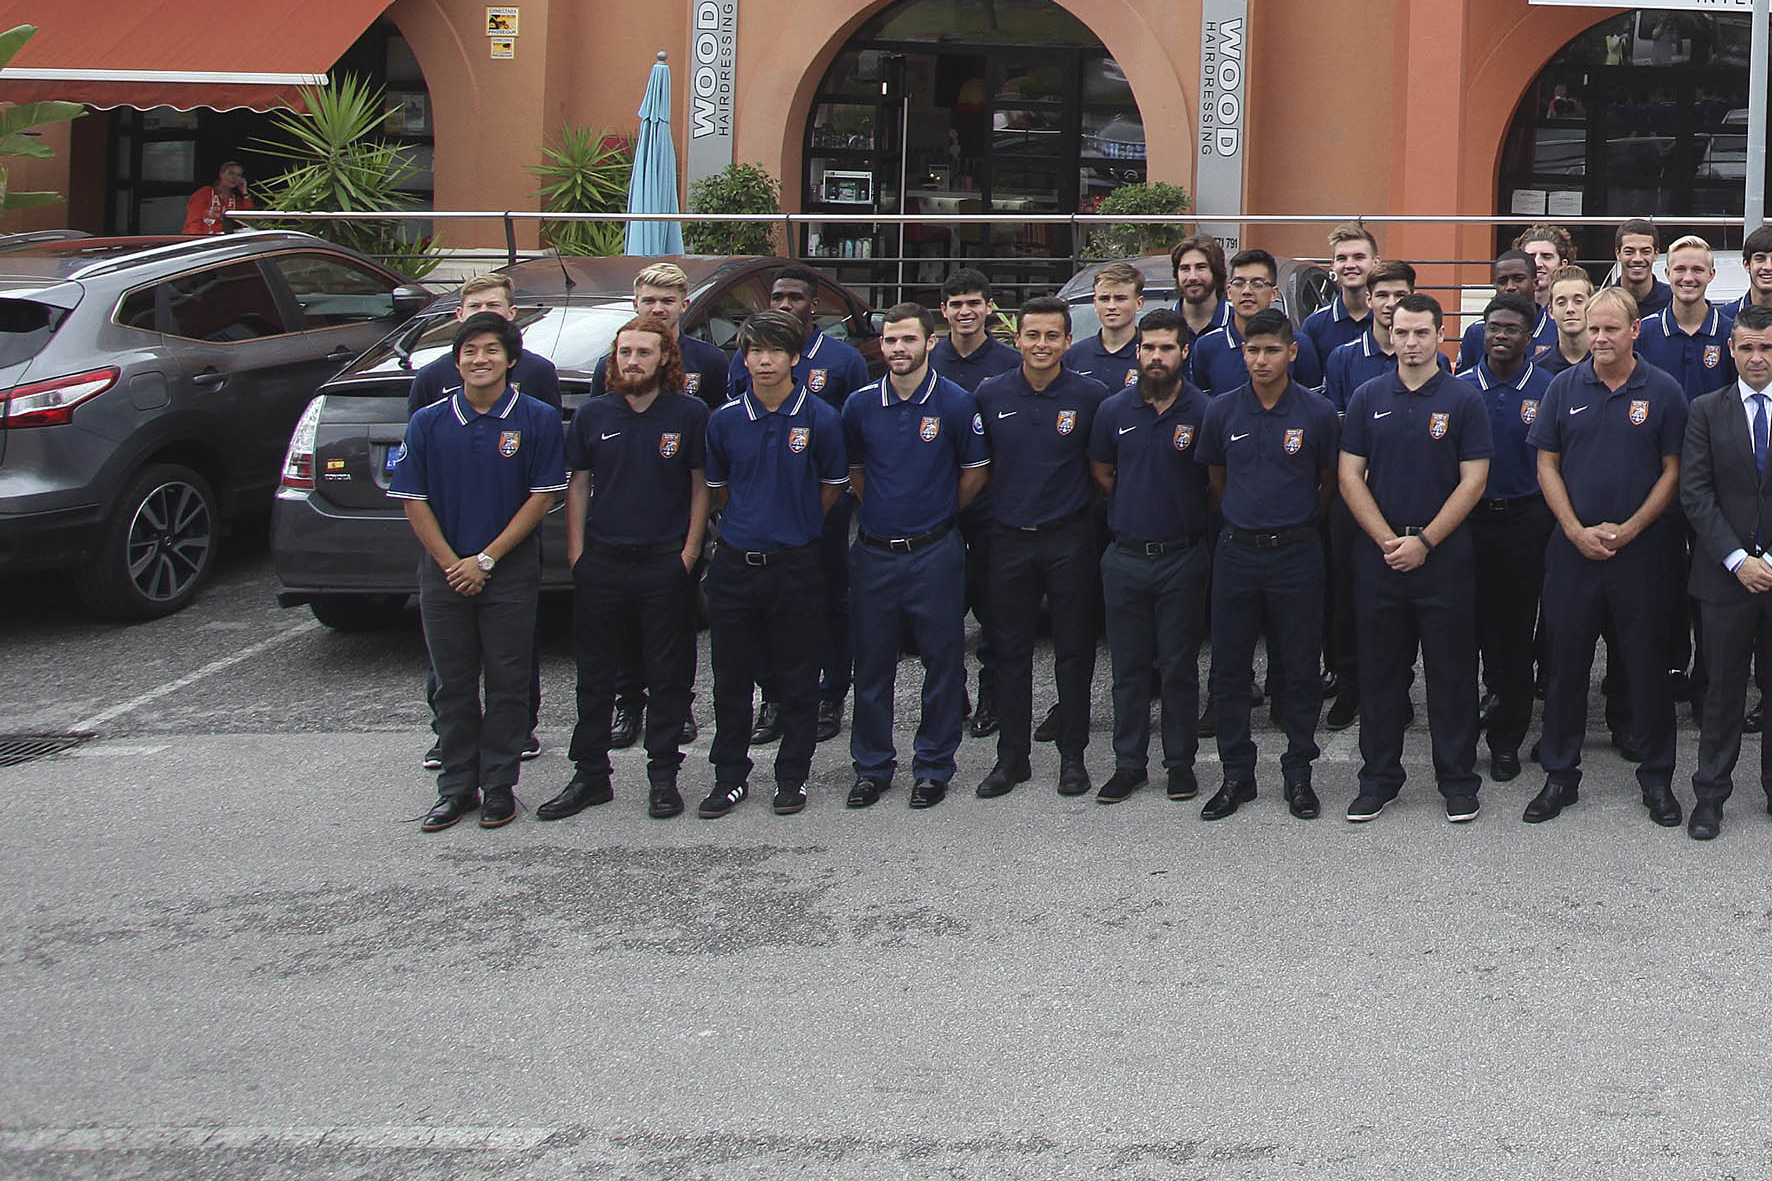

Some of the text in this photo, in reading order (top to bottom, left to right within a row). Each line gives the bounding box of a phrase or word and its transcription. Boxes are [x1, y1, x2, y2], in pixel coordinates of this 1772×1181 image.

[692, 0, 720, 140] WOOD
[718, 2, 734, 136] HAIRDRESSING
[1201, 20, 1217, 156] HAIRDRESSING
[1215, 17, 1243, 158] WOOD
[1225, 237, 1238, 249] 791
